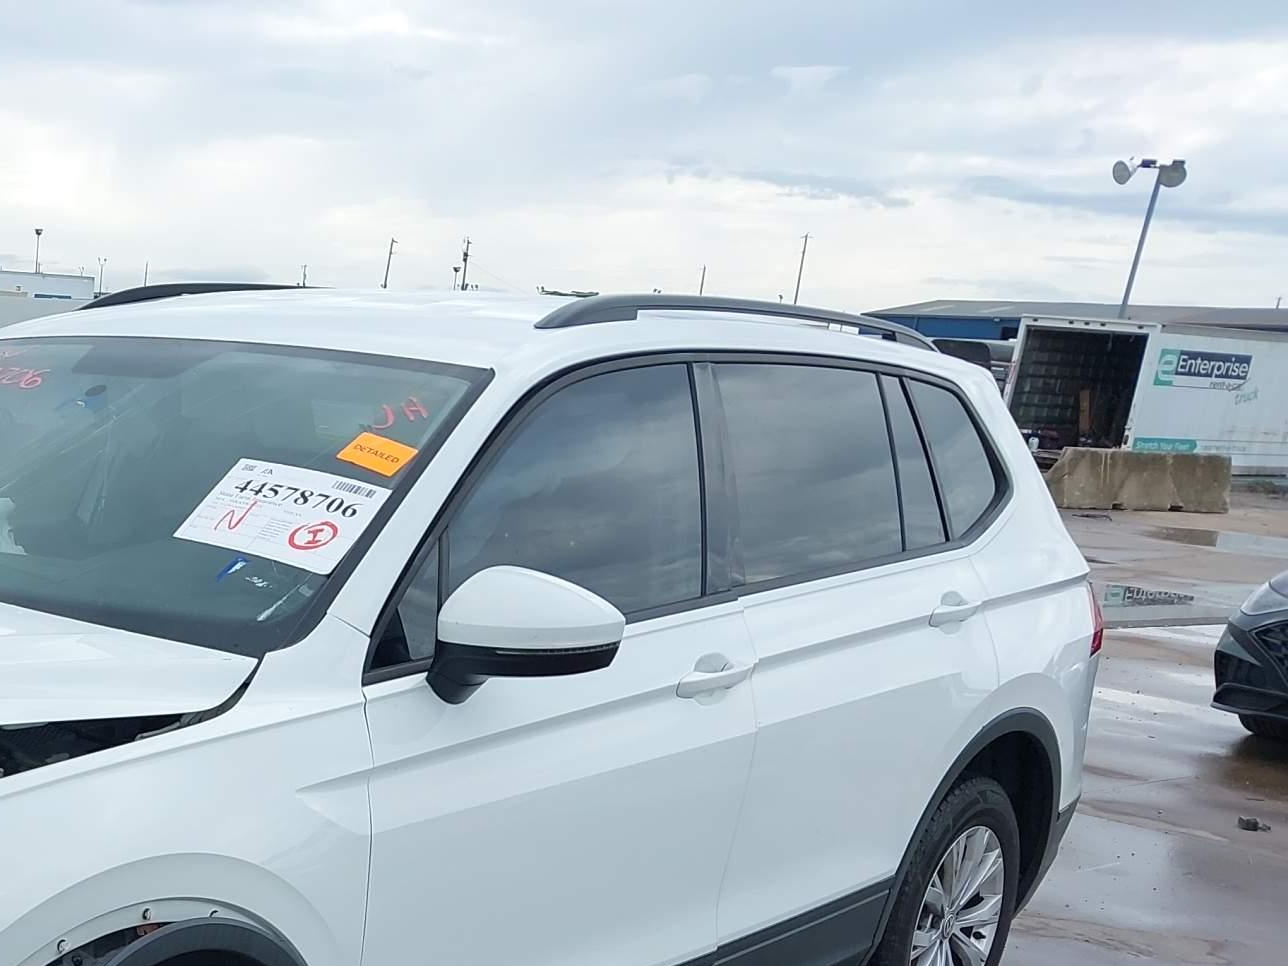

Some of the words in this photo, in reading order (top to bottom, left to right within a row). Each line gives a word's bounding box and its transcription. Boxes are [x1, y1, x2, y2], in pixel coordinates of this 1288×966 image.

[1177, 356, 1248, 379] Enterprise
[353, 443, 400, 464] DETAILED
[234, 479, 365, 518] 44578706
